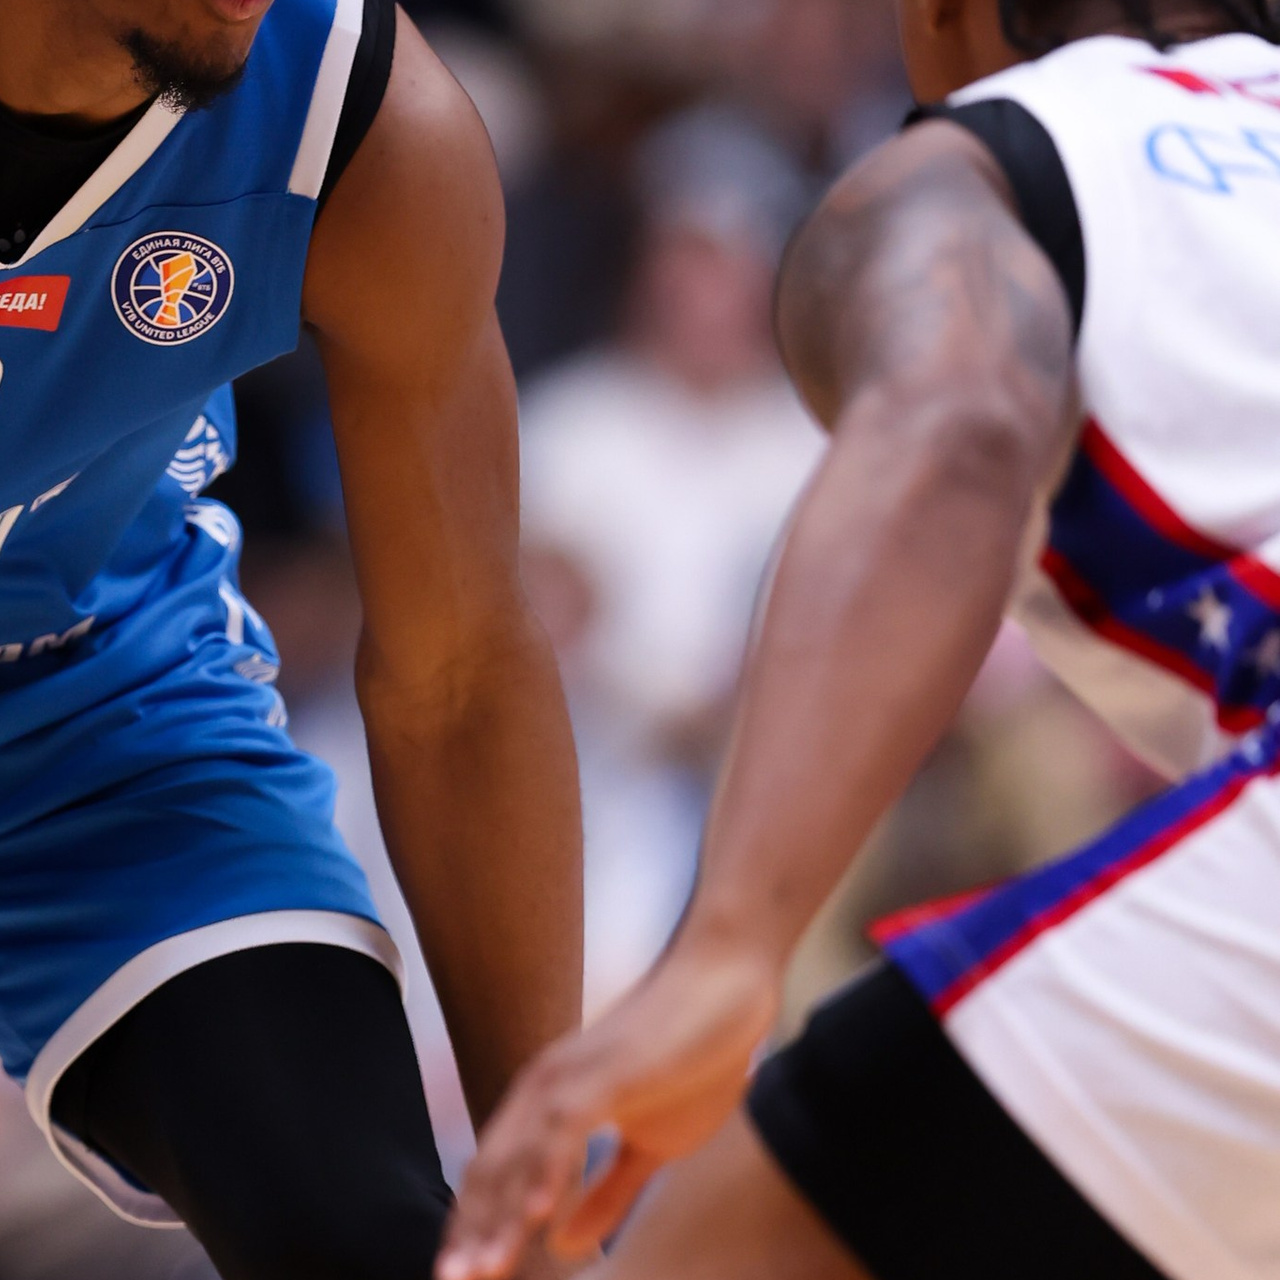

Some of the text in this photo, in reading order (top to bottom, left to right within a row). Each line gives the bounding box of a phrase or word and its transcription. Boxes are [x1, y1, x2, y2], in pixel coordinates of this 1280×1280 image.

[132, 238, 226, 274] ЕДИНАЯ ЛИГА ВТБ
[121, 301, 215, 339] VTB UNITED LEAGUE
